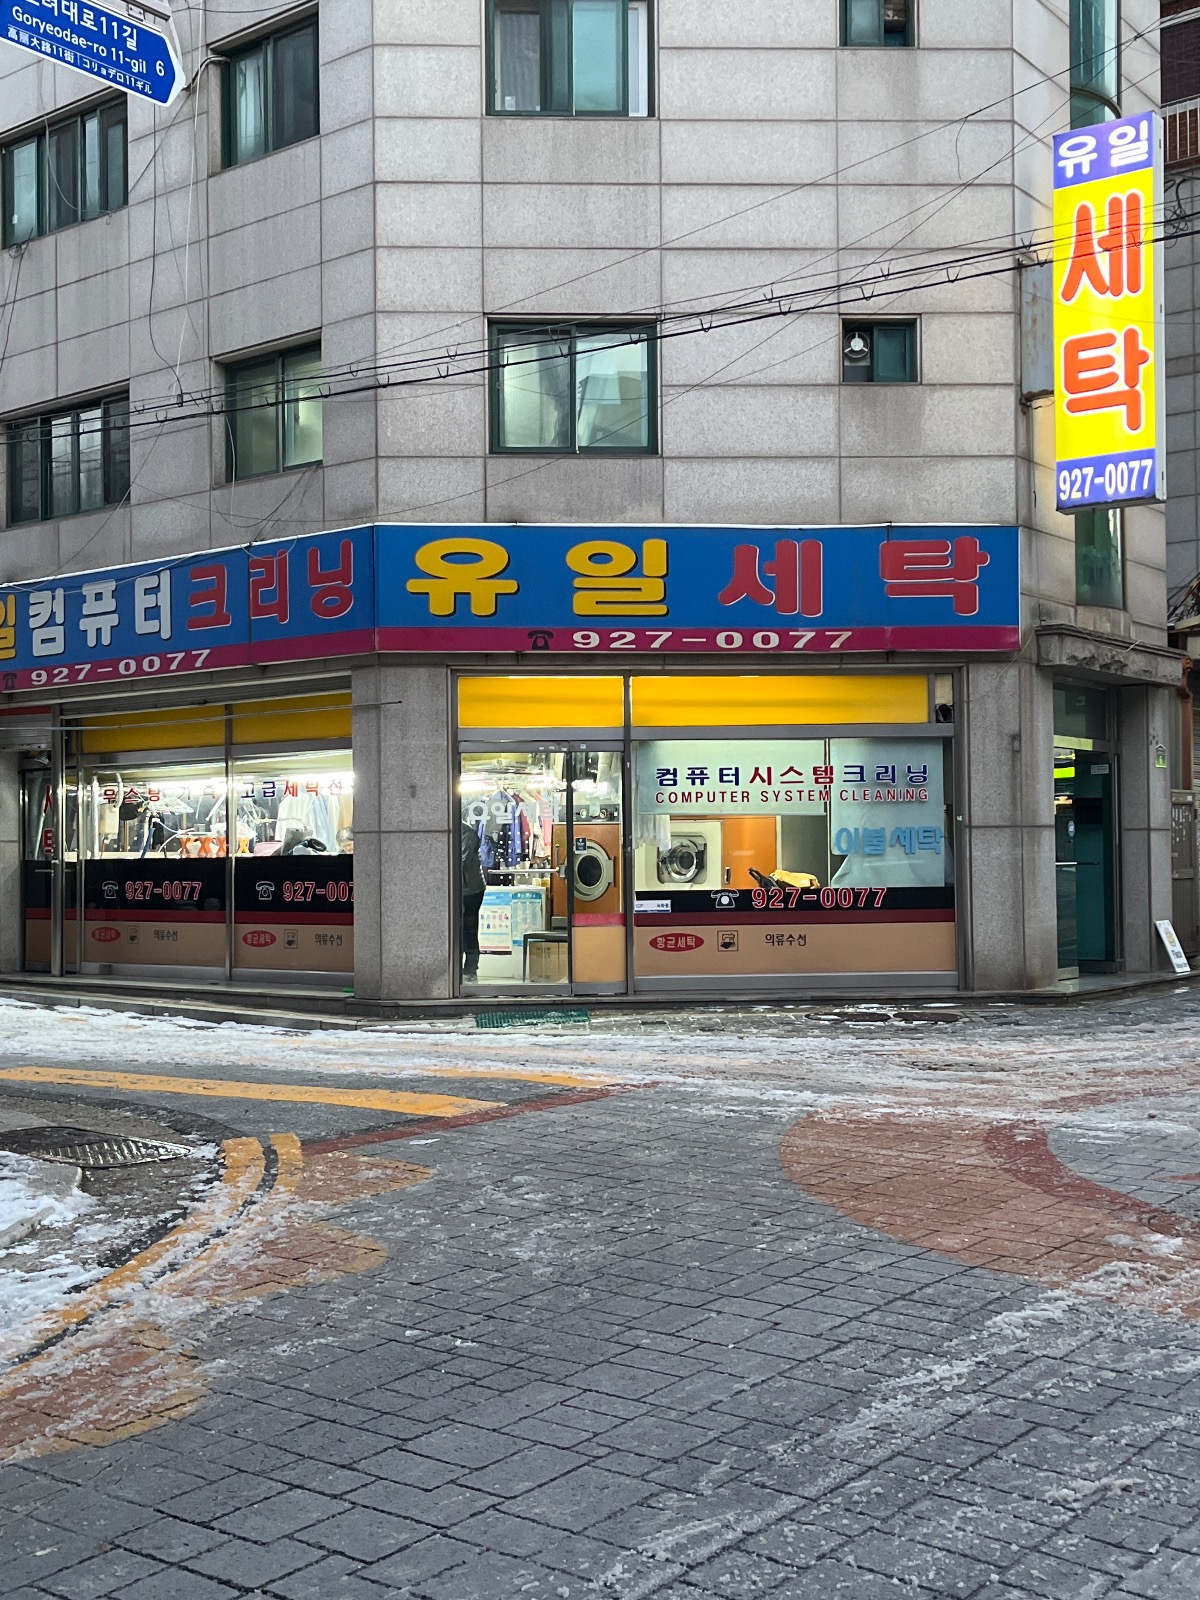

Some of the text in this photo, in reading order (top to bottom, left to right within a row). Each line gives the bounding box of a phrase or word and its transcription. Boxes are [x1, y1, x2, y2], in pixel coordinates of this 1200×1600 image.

[26, 0, 138, 51] 려대로11길
[12, 5, 147, 74] Goryeodae-ro 11-gil
[155, 60, 165, 77] 6
[1057, 118, 1149, 179] 유일
[1060, 191, 1150, 432] 세탁
[1058, 457, 1153, 502] 927-0077
[28, 569, 172, 657] 컴퓨터
[187, 538, 354, 631] 크리닝
[572, 630, 853, 650] 927-0077
[30, 649, 211, 686] 927-0077
[655, 764, 929, 787] 컴퓨터 시스템 크리닝
[655, 788, 929, 804] COMPUTER SYSTEM CLEANING
[835, 826, 945, 856] 이불세탁
[125, 880, 202, 900] 927-0077
[751, 886, 887, 909] 927-0077
[314, 933, 343, 947] 의류수선
[656, 936, 696, 949] 항균세탁
[765, 933, 807, 947] 의류수선
